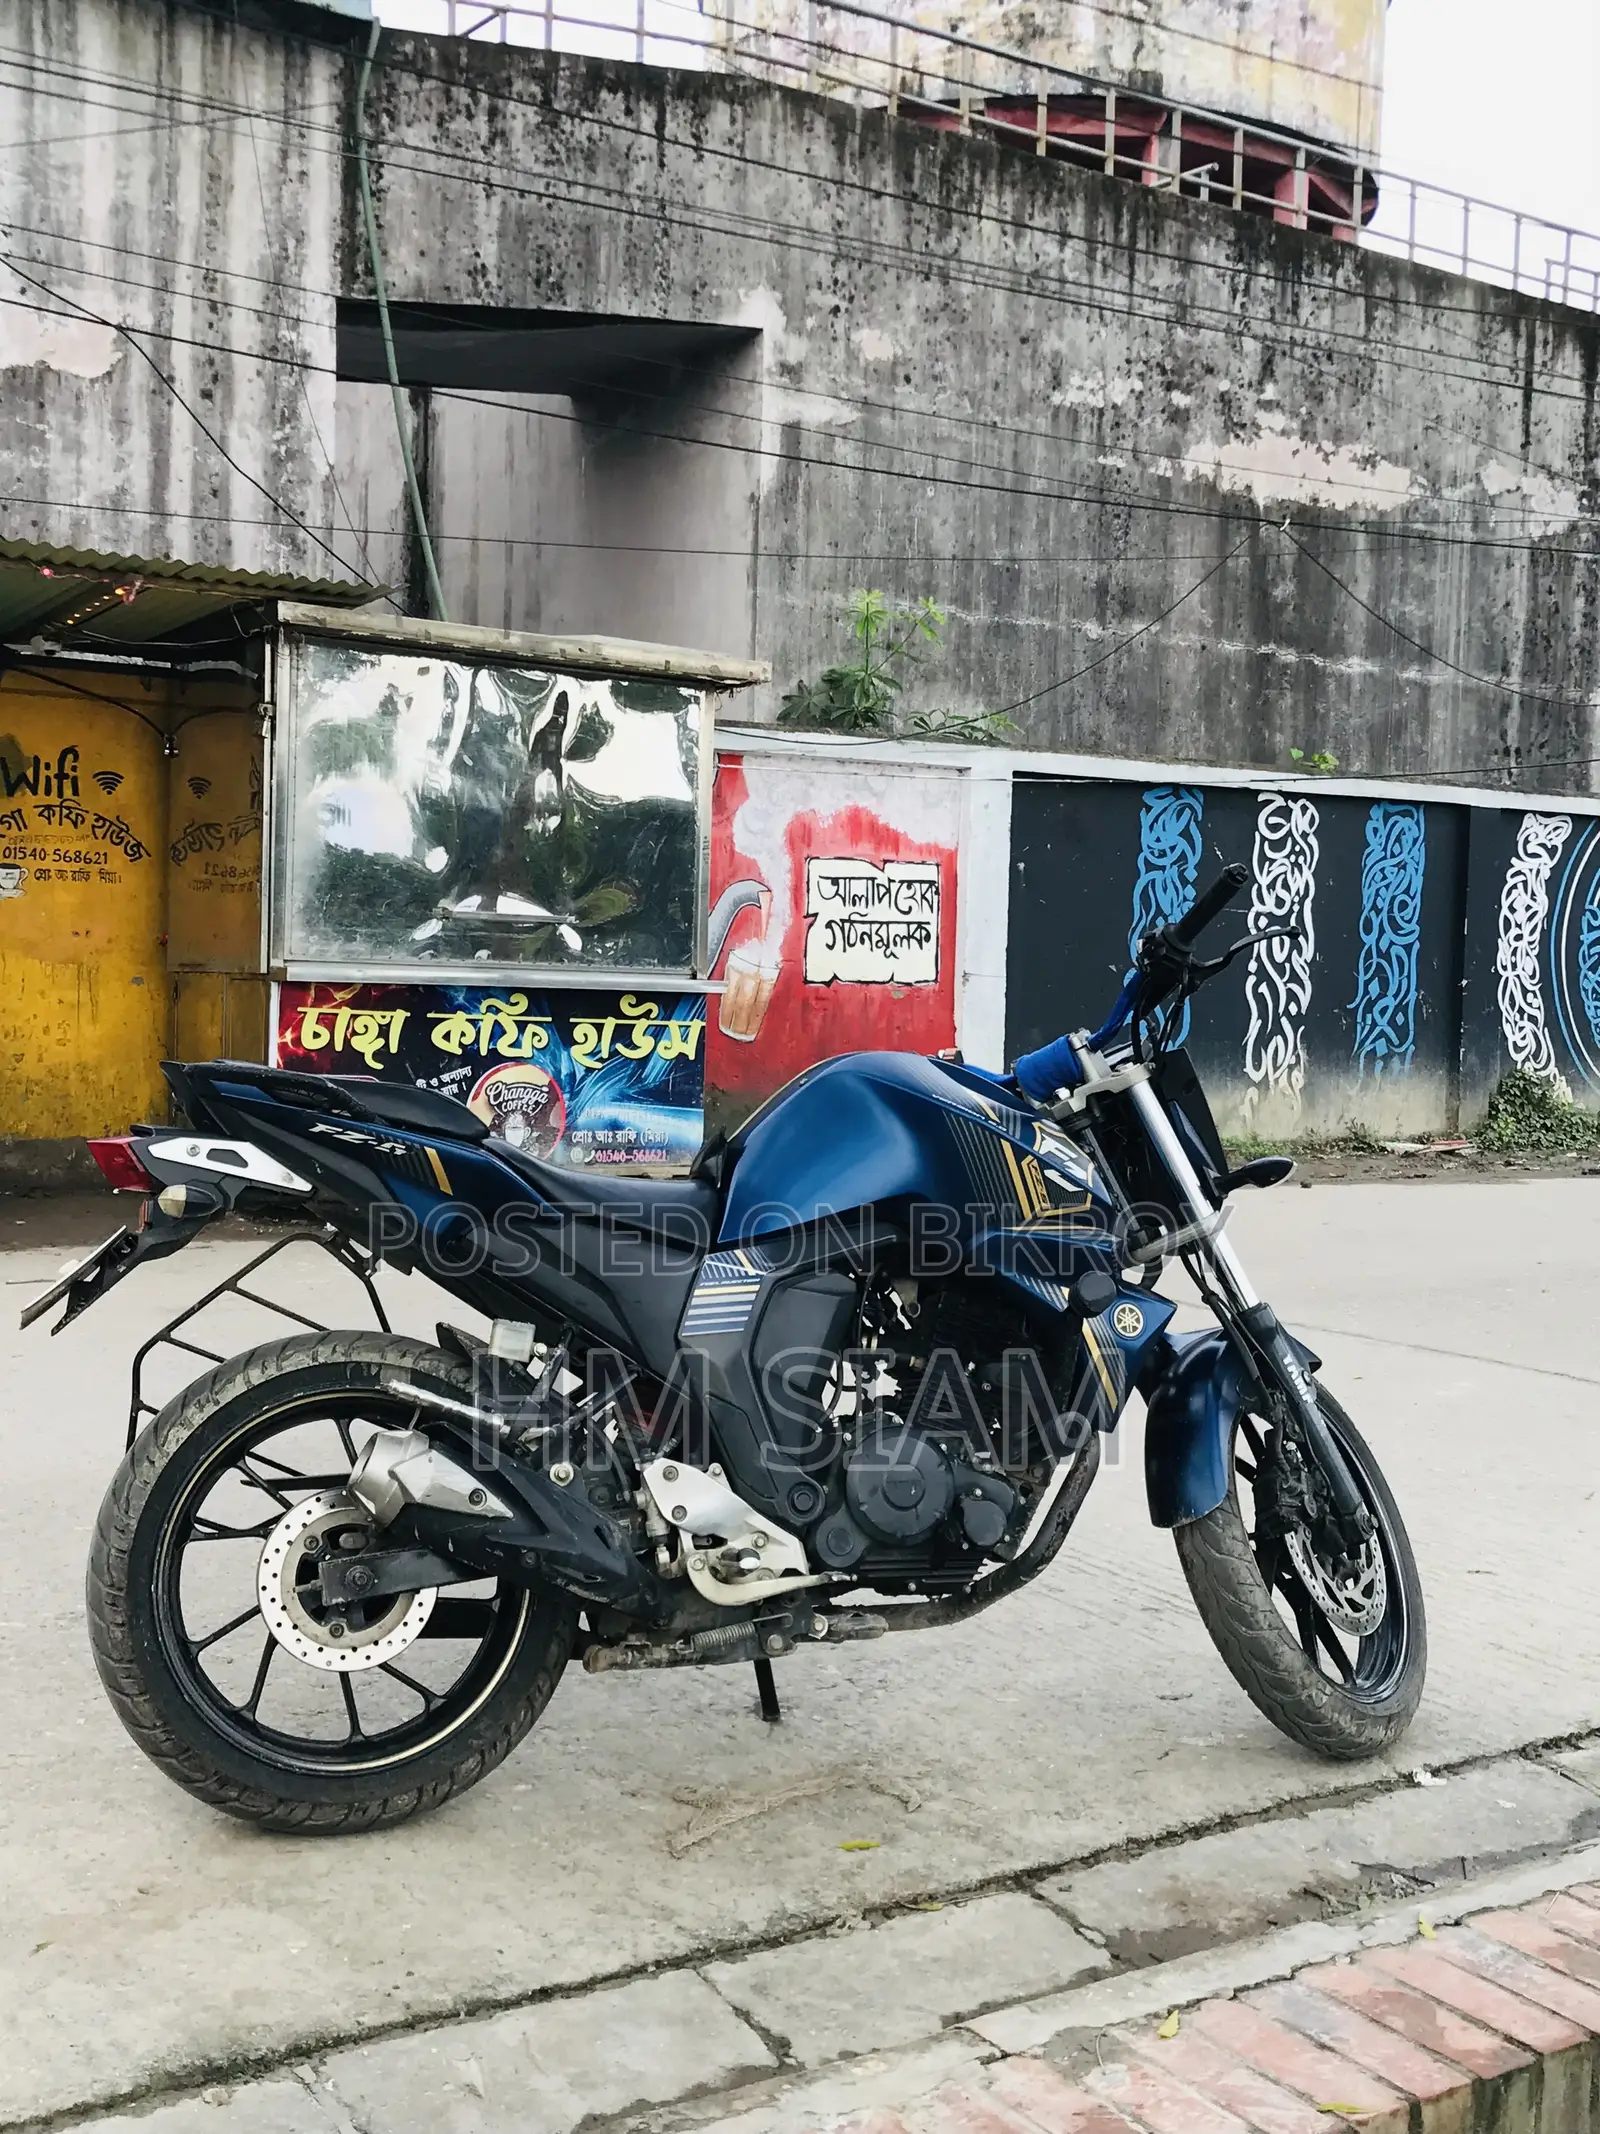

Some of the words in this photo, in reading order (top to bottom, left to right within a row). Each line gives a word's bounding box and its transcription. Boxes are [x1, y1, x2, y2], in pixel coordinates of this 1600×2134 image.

[0, 745, 80, 799] Wifi
[33, 798, 90, 830] কফি
[91, 812, 152, 863] হাউজ
[817, 874, 896, 909] আলাপ
[894, 878, 939, 915] হোক
[824, 911, 932, 960] গঠনমূলক
[426, 992, 553, 1060] কফি
[569, 994, 707, 1070] হাউস
[439, 1065, 472, 1083] অন্যান্য
[485, 1079, 549, 1105] Changga
[501, 1101, 537, 1115] COFFEE
[615, 1127, 638, 1145] রাফি
